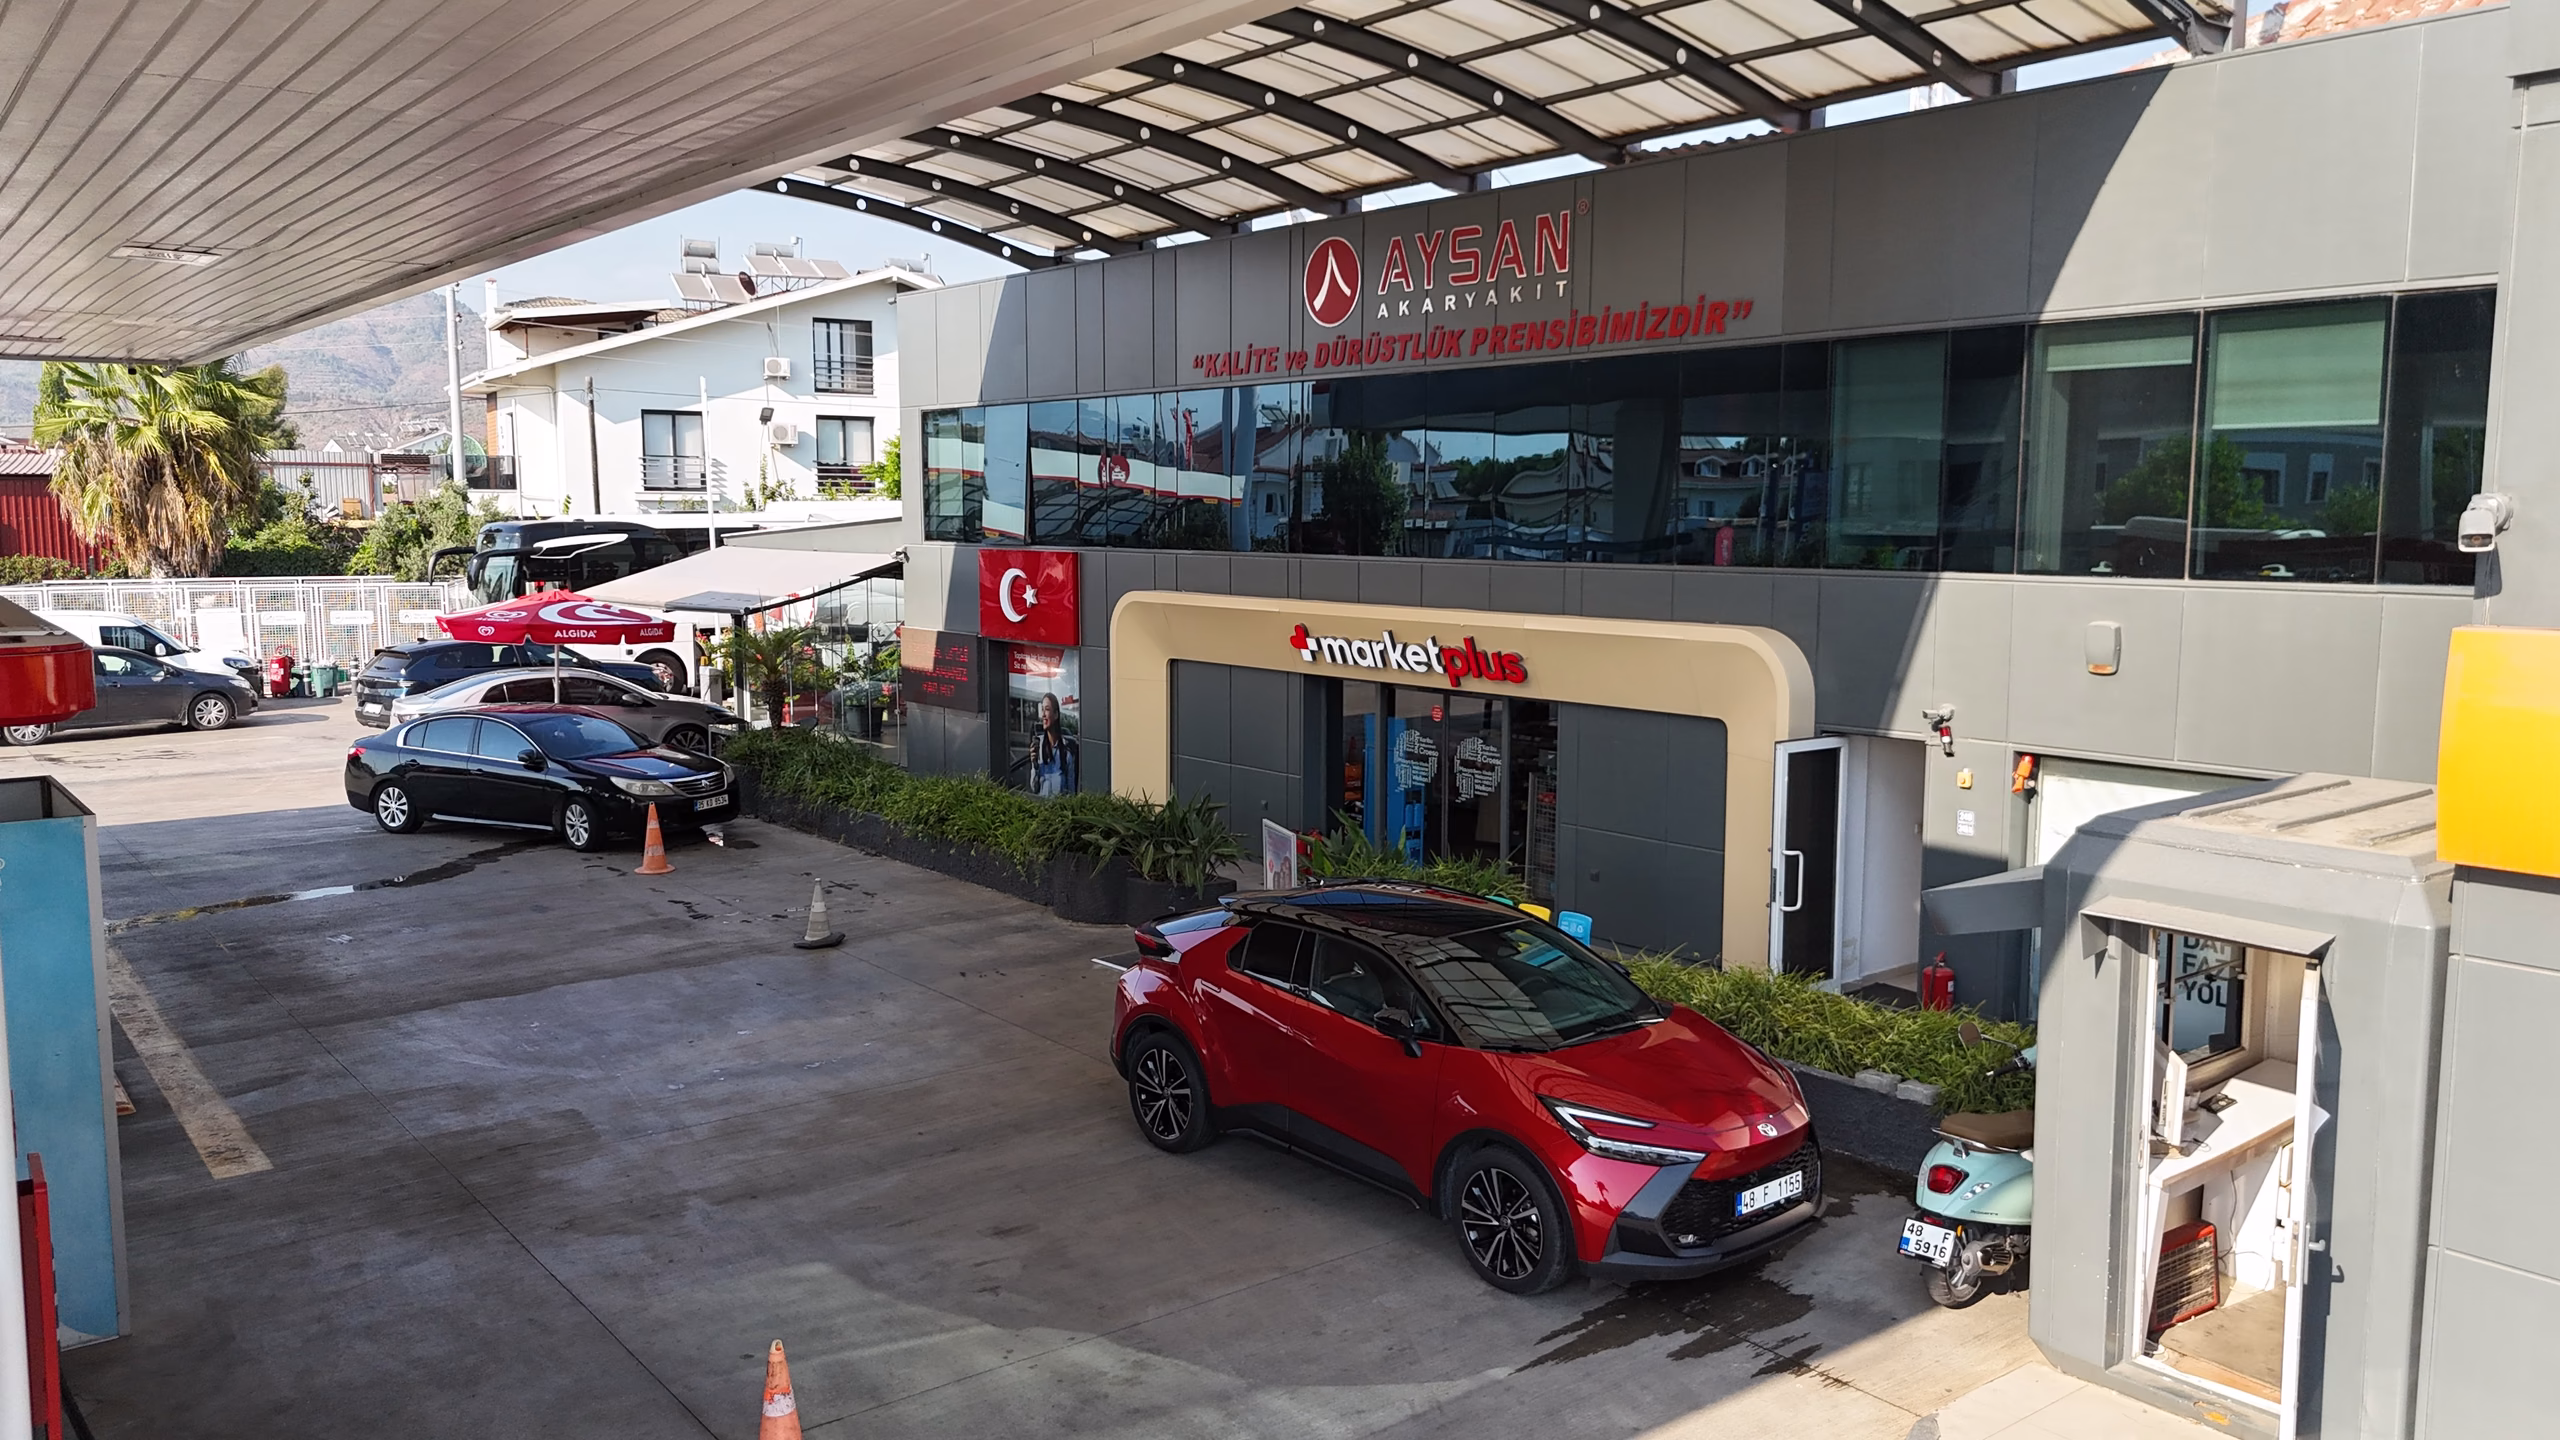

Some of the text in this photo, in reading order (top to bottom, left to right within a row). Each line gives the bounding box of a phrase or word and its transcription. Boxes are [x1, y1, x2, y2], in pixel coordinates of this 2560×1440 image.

[1377, 210, 1570, 295] AYSAN
[1377, 280, 1568, 319] AKARYAKIT
[1284, 350, 1308, 370] ve
[1313, 325, 1466, 369] DÜRÜSTLÜK
[2182, 980, 2227, 1008] YOL
[1743, 1174, 1800, 1210] 48 F 1155
[1907, 1223, 1951, 1244] 48 F
[1914, 1239, 1948, 1258] 5916
